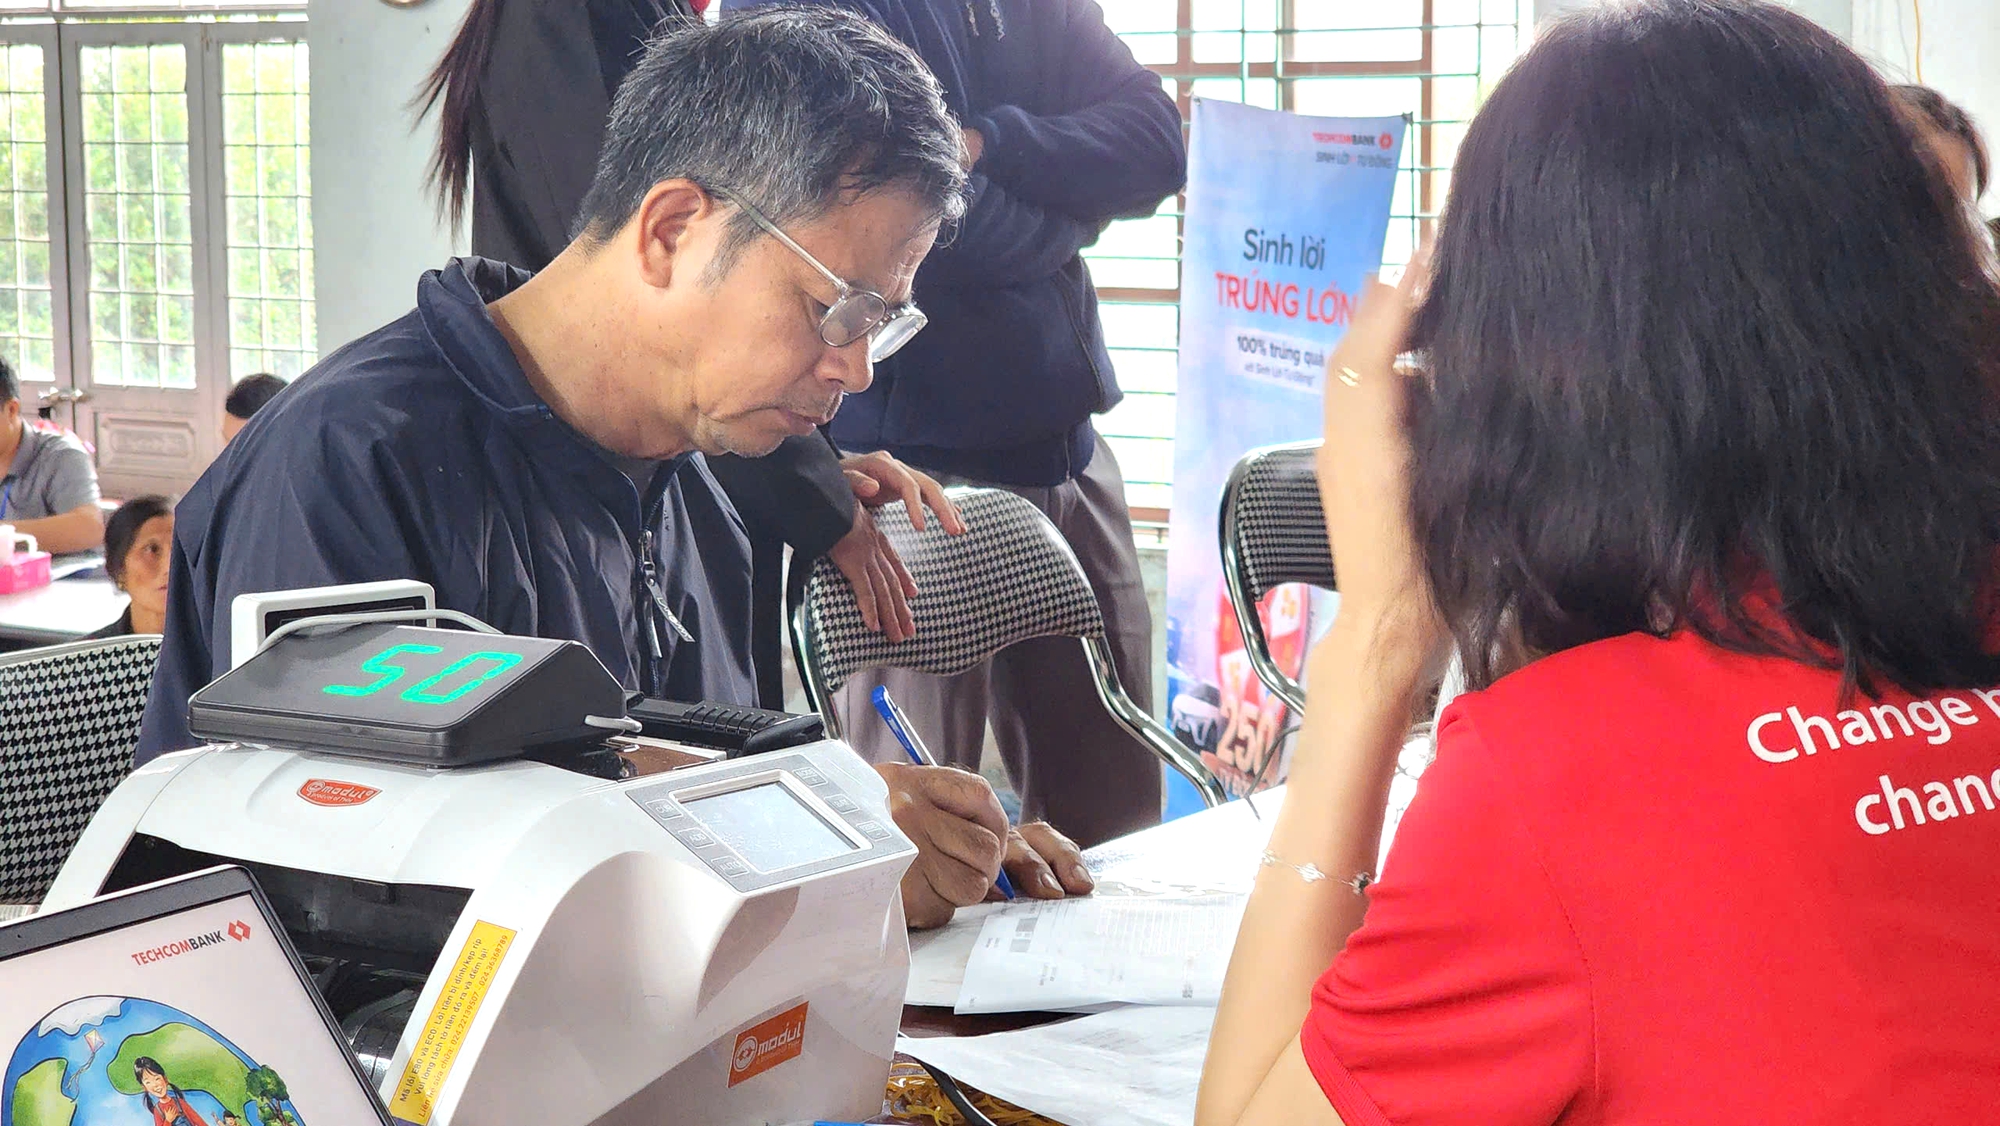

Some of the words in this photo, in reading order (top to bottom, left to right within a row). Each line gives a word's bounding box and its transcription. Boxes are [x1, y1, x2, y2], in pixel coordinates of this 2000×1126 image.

[1243, 229, 1293, 266] Sinh
[1300, 234, 1326, 271] lời
[1215, 270, 1299, 318] TRÚNG
[1306, 281, 1357, 326] LỚN
[1237, 335, 1267, 356] 100%
[1269, 341, 1300, 366] trúng
[322, 643, 524, 705] 50
[1746, 697, 1979, 763] Change
[1855, 774, 2000, 835] chan
[131, 930, 226, 967] TECHCOMBANK
[412, 1058, 423, 1074] E80
[421, 1047, 430, 1057] và
[449, 985, 459, 994] bị
[414, 1081, 426, 1095] Vui
[423, 1061, 436, 1080] lòng
[431, 1042, 444, 1060] tách
[440, 1031, 448, 1040] tờ
[445, 1014, 457, 1030] tiền
[453, 1001, 463, 1013] đó
[460, 992, 468, 1001] ra
[464, 981, 473, 991] và
[469, 962, 482, 979] đếm
[757, 1021, 802, 1056] modul
[418, 1099, 431, 1118] Liên
